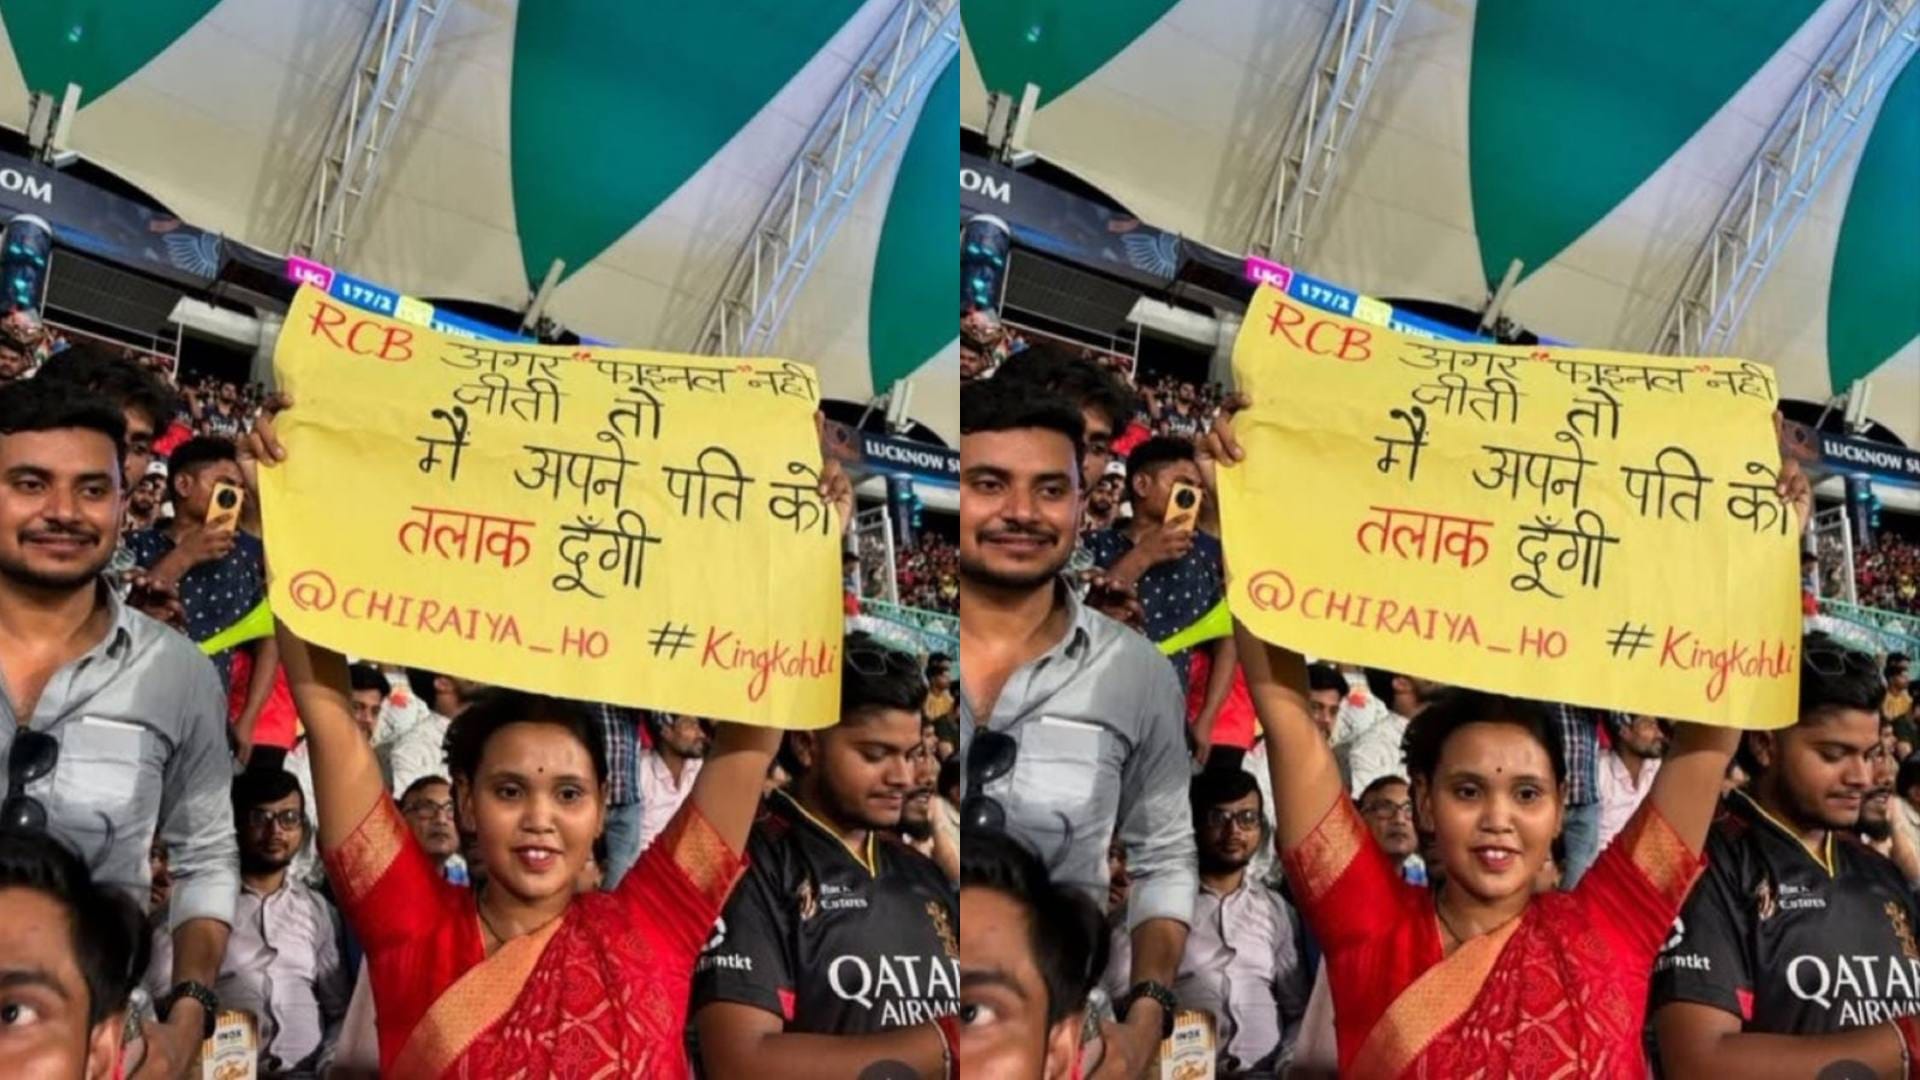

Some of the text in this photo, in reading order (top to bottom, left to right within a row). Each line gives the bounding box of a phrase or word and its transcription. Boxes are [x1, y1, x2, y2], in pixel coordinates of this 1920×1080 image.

[342, 282, 393, 312] 177/2
[1300, 282, 1352, 312] 177/2
[308, 300, 413, 362] RCB
[440, 341, 569, 380] अगर
[1266, 300, 1372, 362] RCB
[1398, 341, 1528, 380] अगर
[453, 373, 665, 441] जीती तो
[1412, 373, 1624, 441] जीती तो
[513, 431, 640, 508] अपने
[661, 446, 755, 522] पति
[768, 461, 830, 536] को
[865, 440, 960, 474] LUCKNOW S
[1472, 431, 1598, 508] अपने
[1620, 446, 1714, 522] पति
[1726, 461, 1788, 536] को
[1824, 440, 1902, 470] LUCKNOW
[398, 505, 536, 568] तलाक
[1356, 505, 1494, 568] तलाक
[288, 569, 610, 660] @CHIRAIYA_HO
[1246, 569, 1568, 660] @CHIRAIYA_HO
[880, 999, 960, 1026] AIRWA
